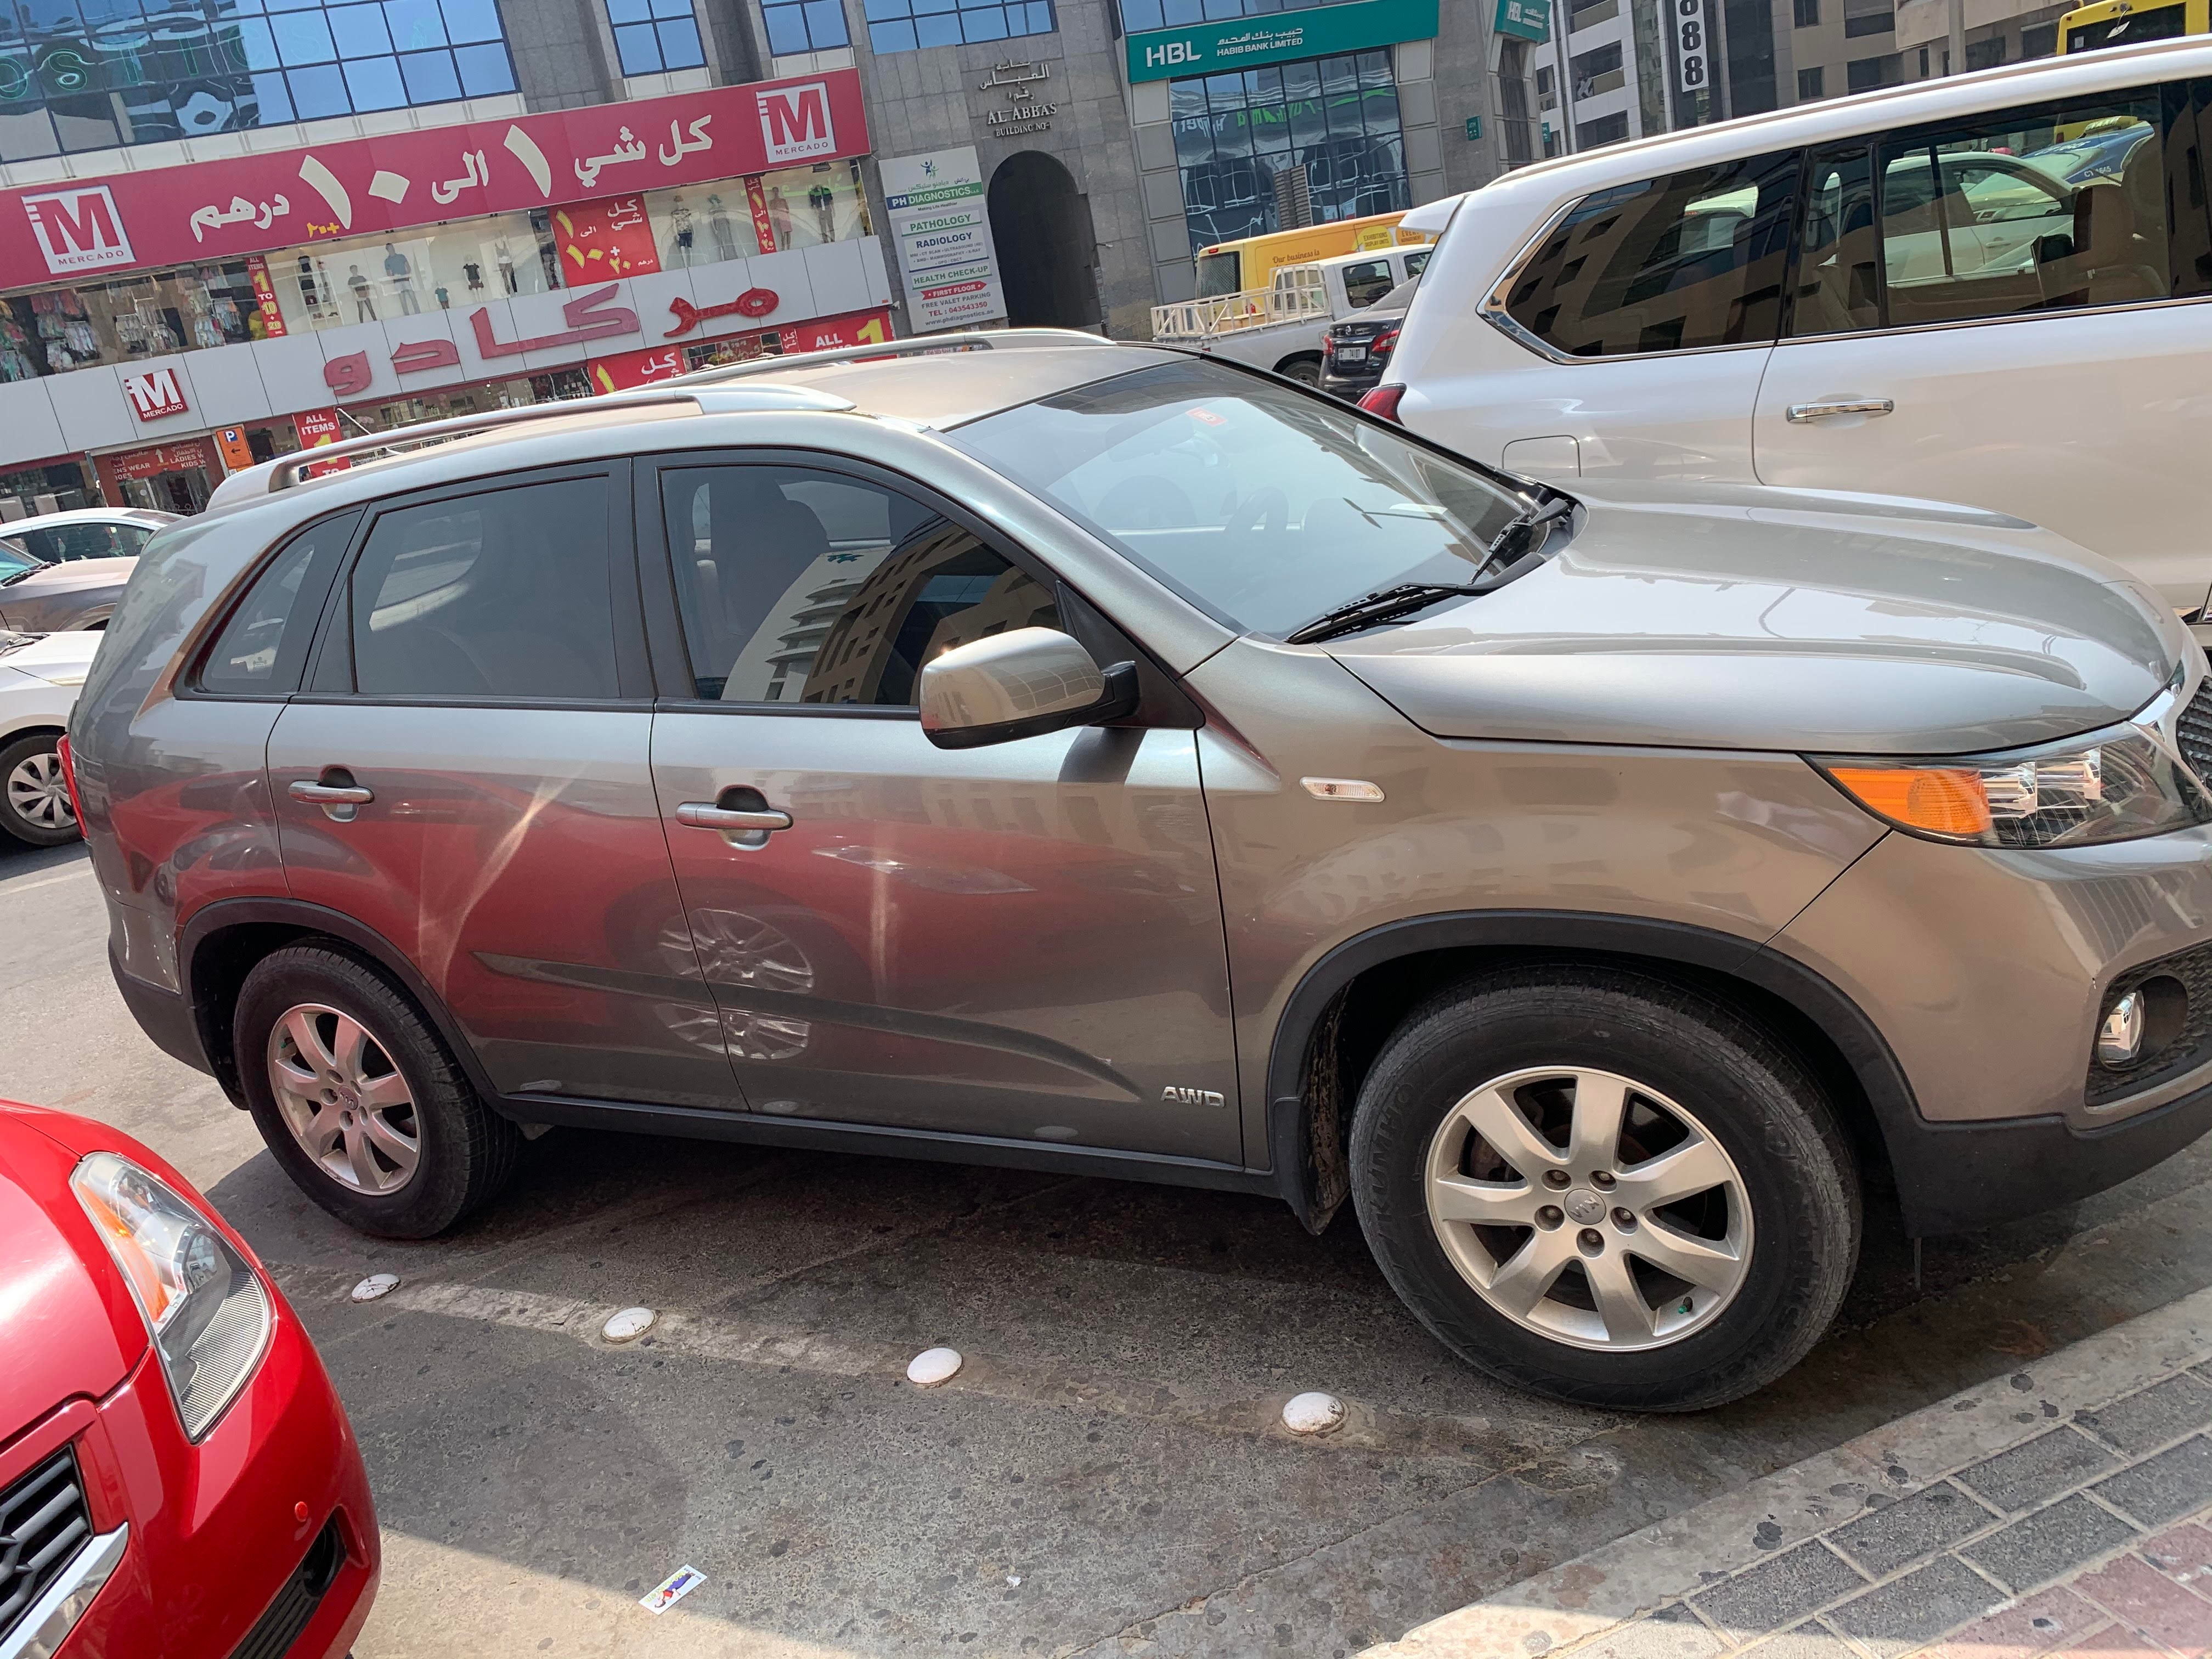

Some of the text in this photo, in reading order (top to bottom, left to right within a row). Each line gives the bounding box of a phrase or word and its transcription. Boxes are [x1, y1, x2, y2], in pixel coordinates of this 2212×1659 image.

[1146, 41, 1203, 67] HBL
[1217, 37, 1303, 57] HABIB BANK LIMITED
[980, 63, 1049, 89] العباس
[988, 103, 1057, 125] AL ABBAS
[996, 123, 1034, 137] BUILDING
[659, 114, 713, 167] كل
[776, 142, 828, 155] MERCADO
[574, 126, 646, 188] شي
[432, 149, 489, 204] الى
[298, 154, 410, 230] ١٠
[892, 196, 907, 207] PH
[909, 186, 971, 204] DIAGNOSTICS
[607, 198, 638, 217] كل
[190, 193, 290, 243] درهم
[611, 212, 642, 230] شي
[910, 214, 972, 232] PATHOLOGY
[916, 232, 972, 249] RADIOLOGY
[1363, 232, 1388, 241] EXHIBITIONS
[58, 250, 125, 266] MERCADO
[1273, 256, 1285, 264] Our
[1287, 251, 1313, 261] business
[253, 270, 270, 292] 1
[913, 266, 988, 285] HEALTH CHECK-UP
[258, 292, 273, 301] TO
[933, 284, 976, 297] FIRST FLOOR
[940, 297, 961, 306] VALET
[962, 292, 991, 302] PARKING
[261, 301, 278, 315] 10
[949, 301, 988, 313] 043543350
[925, 309, 994, 326] www.phdiagnostics.ae
[815, 333, 843, 348] ALL
[641, 352, 677, 375] كل
[143, 403, 183, 419] MERCADO
[306, 413, 326, 425] ALL
[225, 431, 235, 442] P
[301, 422, 336, 436] ITEMS
[128, 462, 151, 471] WEAR
[170, 454, 196, 464] LADIES
[180, 460, 199, 469] KIDS
[1160, 1086, 1225, 1108] AWD
